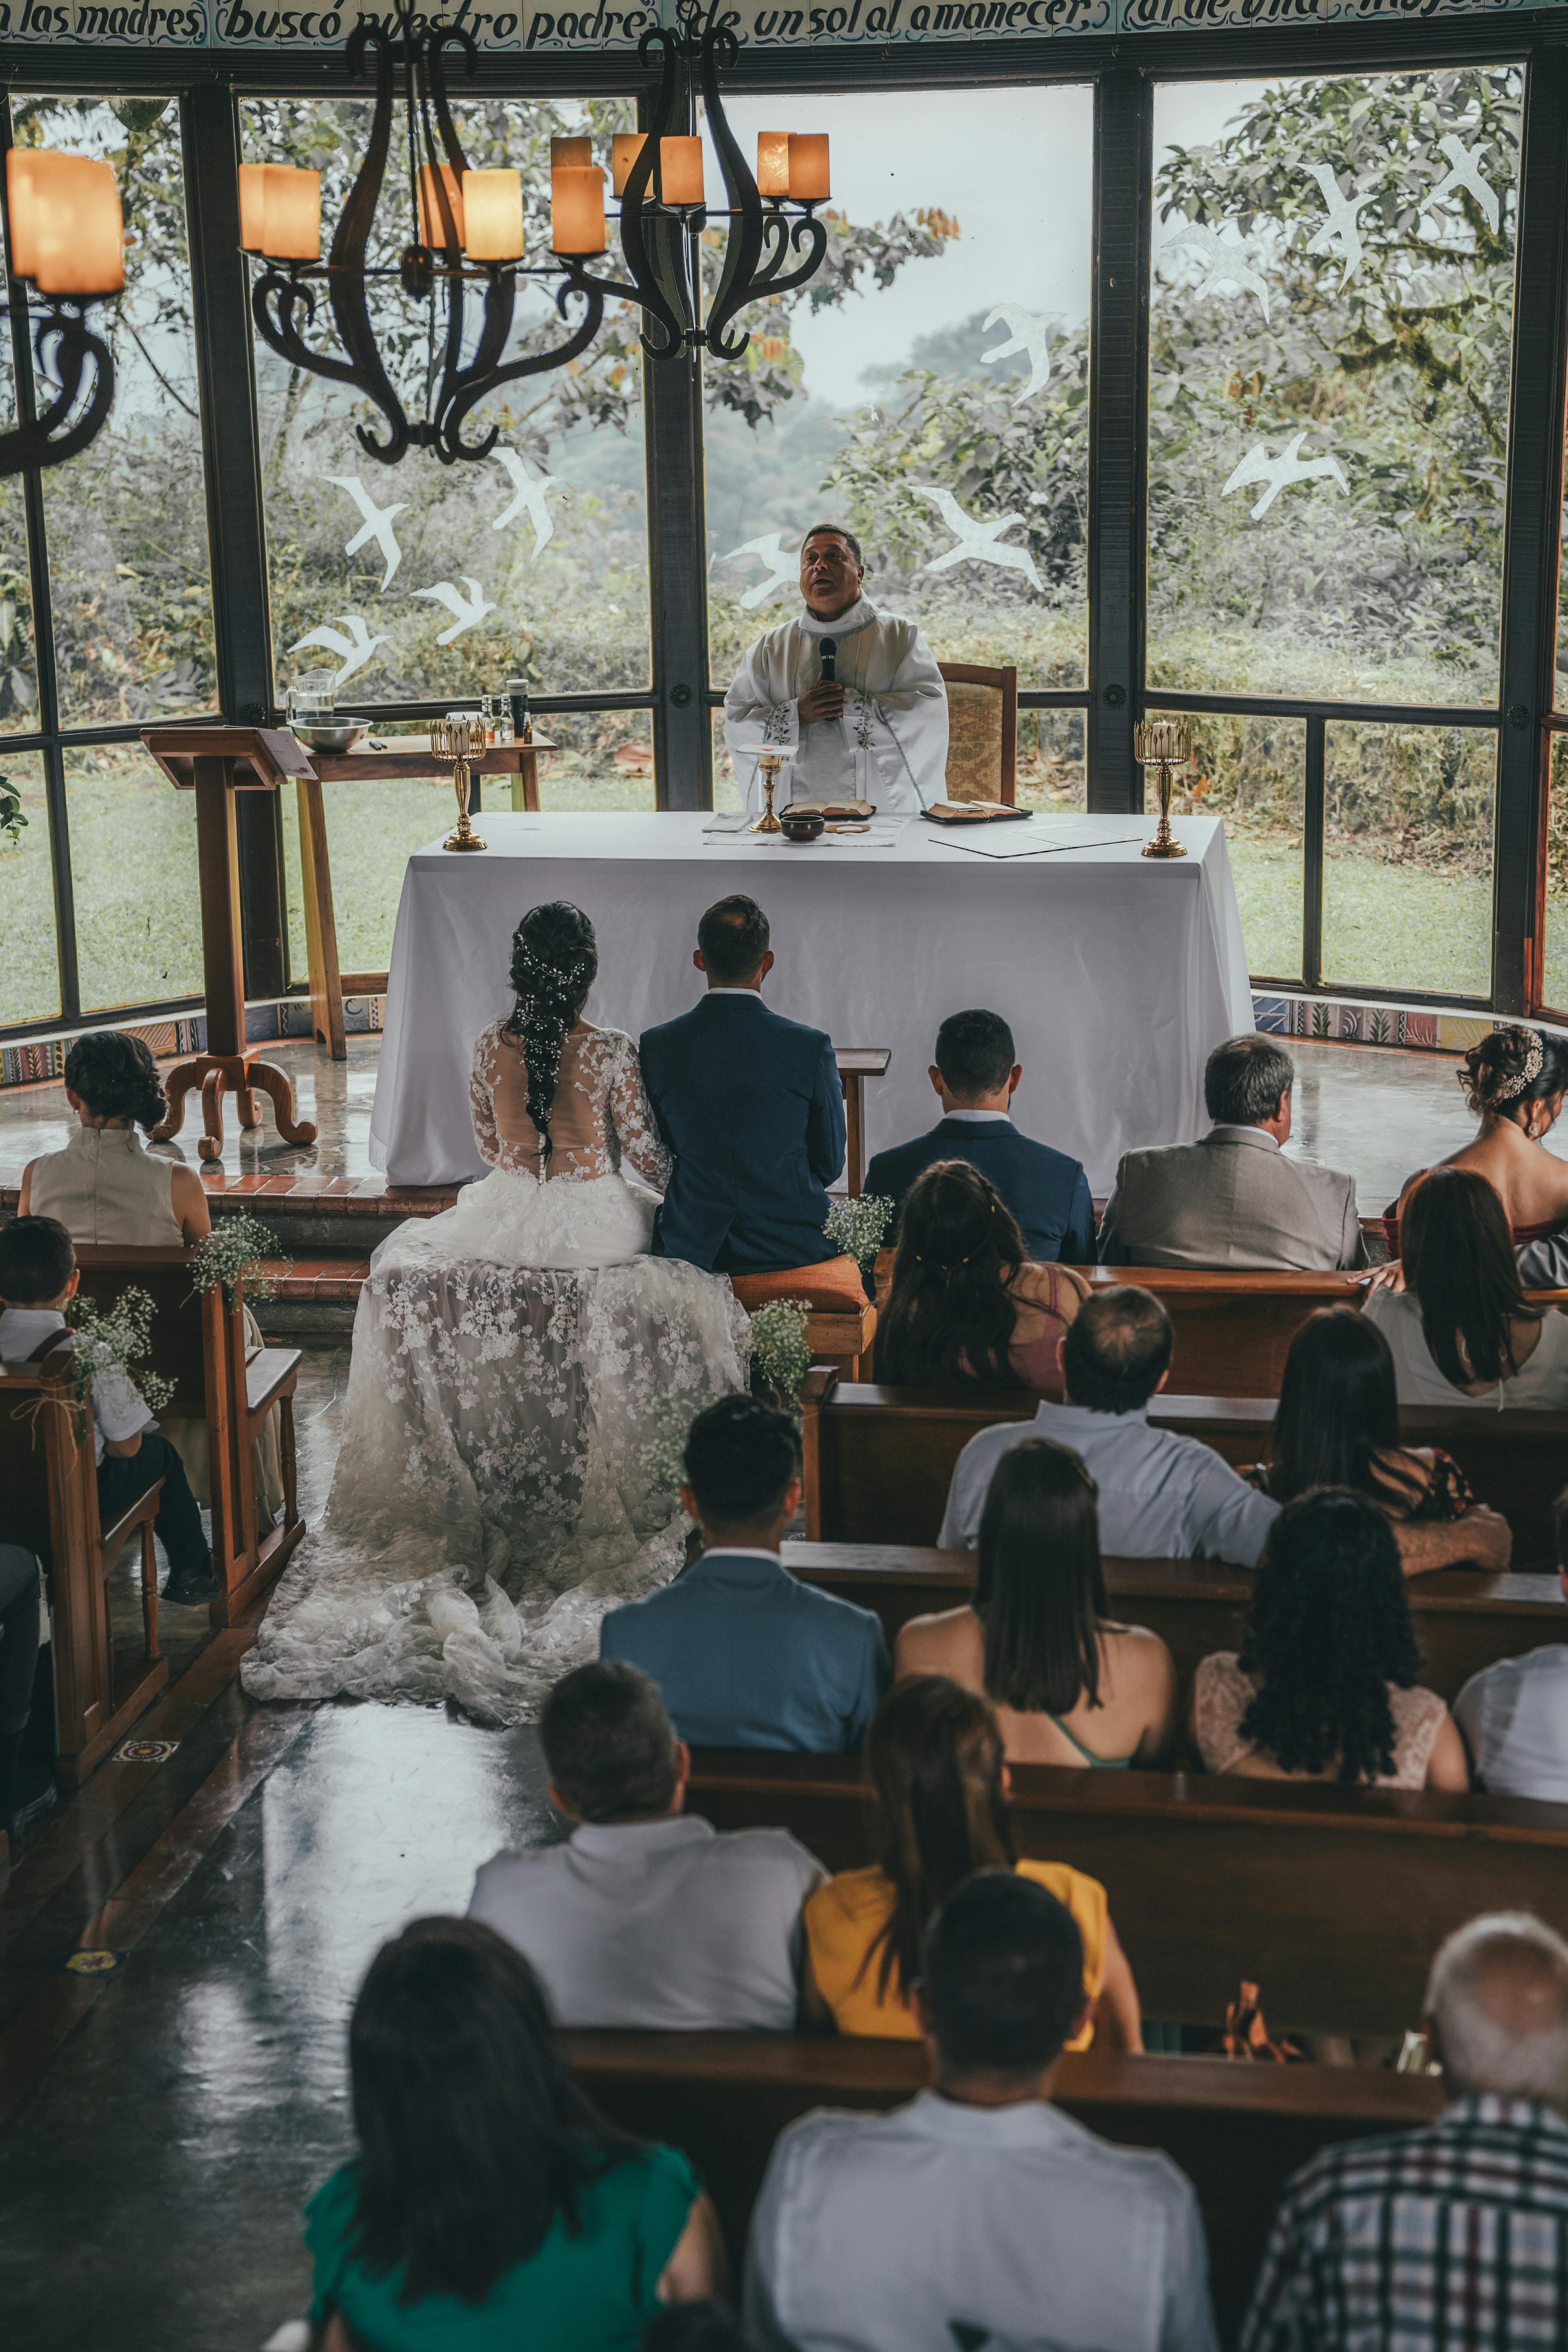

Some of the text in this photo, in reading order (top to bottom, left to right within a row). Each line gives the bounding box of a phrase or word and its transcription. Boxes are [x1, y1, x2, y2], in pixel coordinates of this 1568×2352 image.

[19, 0, 70, 33] las
[224, 0, 344, 38] buscó
[357, 0, 518, 39] nuestro
[691, 0, 741, 37] de
[754, 11, 804, 36] un
[806, 0, 862, 34] sol
[866, 0, 901, 32] al
